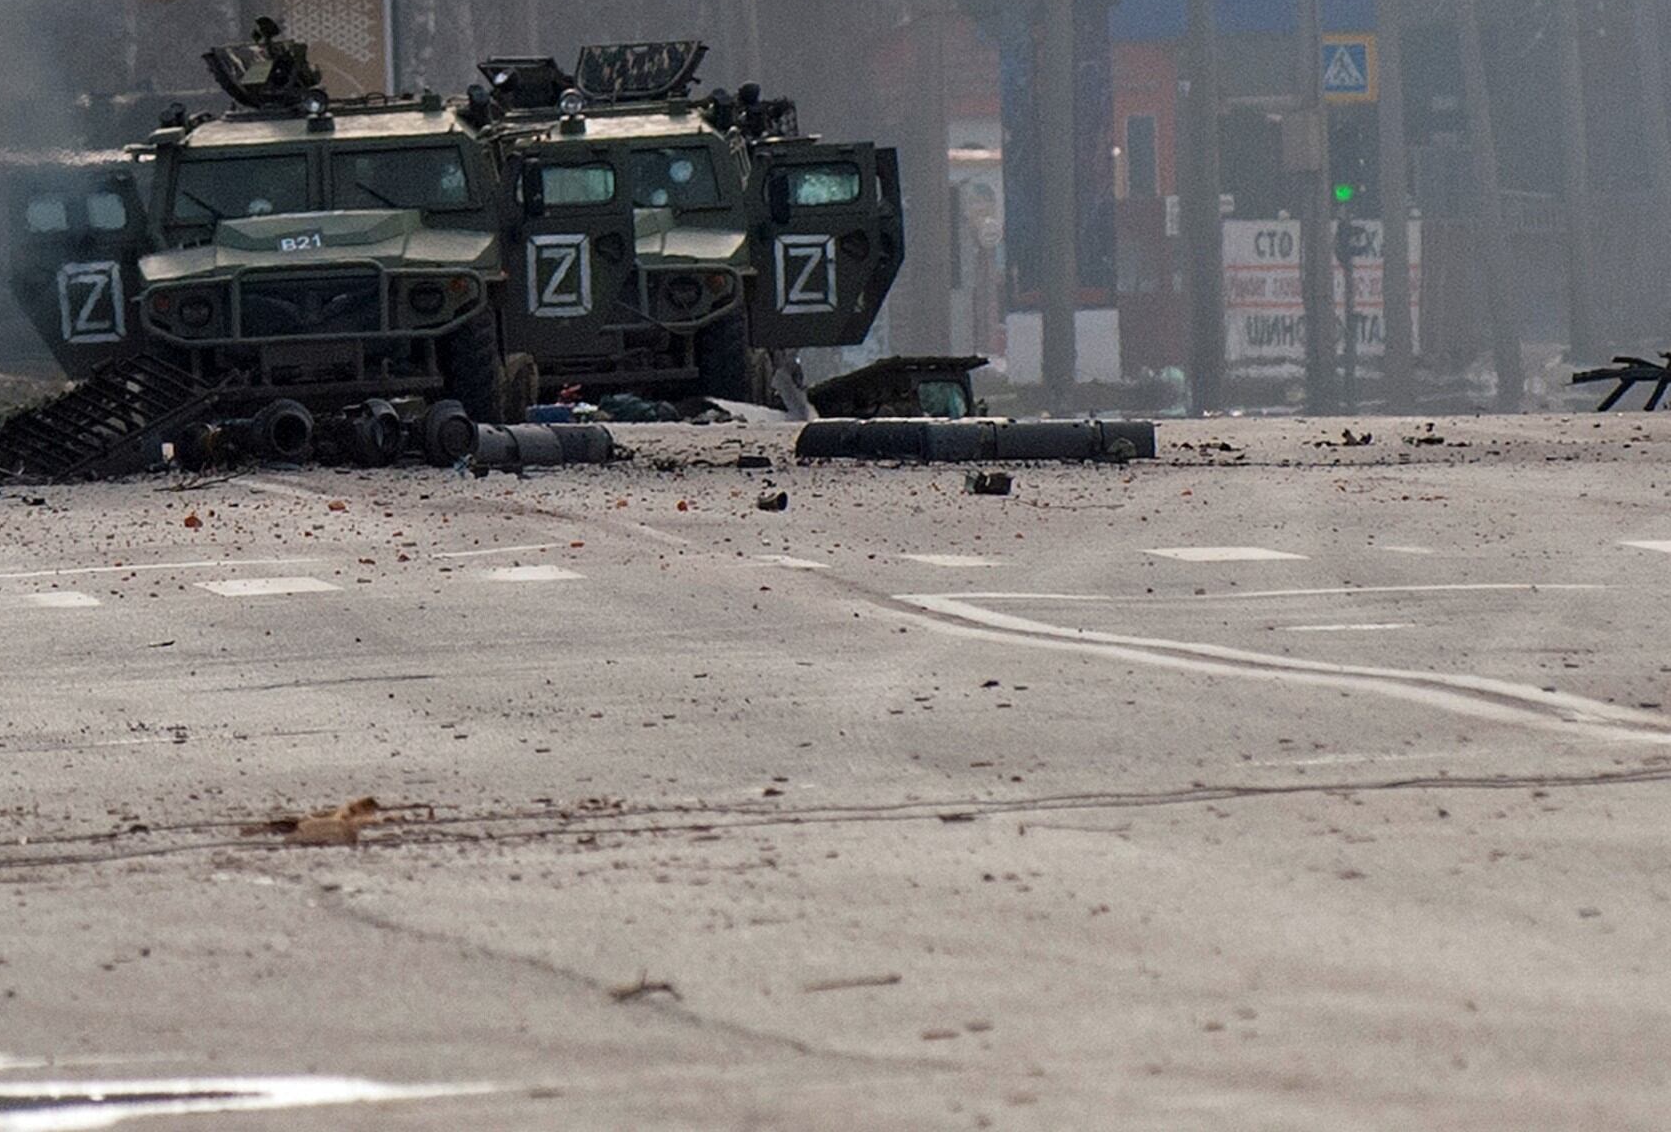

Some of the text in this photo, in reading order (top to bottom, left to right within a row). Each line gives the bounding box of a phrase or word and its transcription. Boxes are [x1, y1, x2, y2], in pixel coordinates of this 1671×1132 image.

[1254, 231, 1294, 258] СТО
[542, 248, 577, 302] Z
[788, 247, 825, 301] Z
[70, 274, 109, 330] Z
